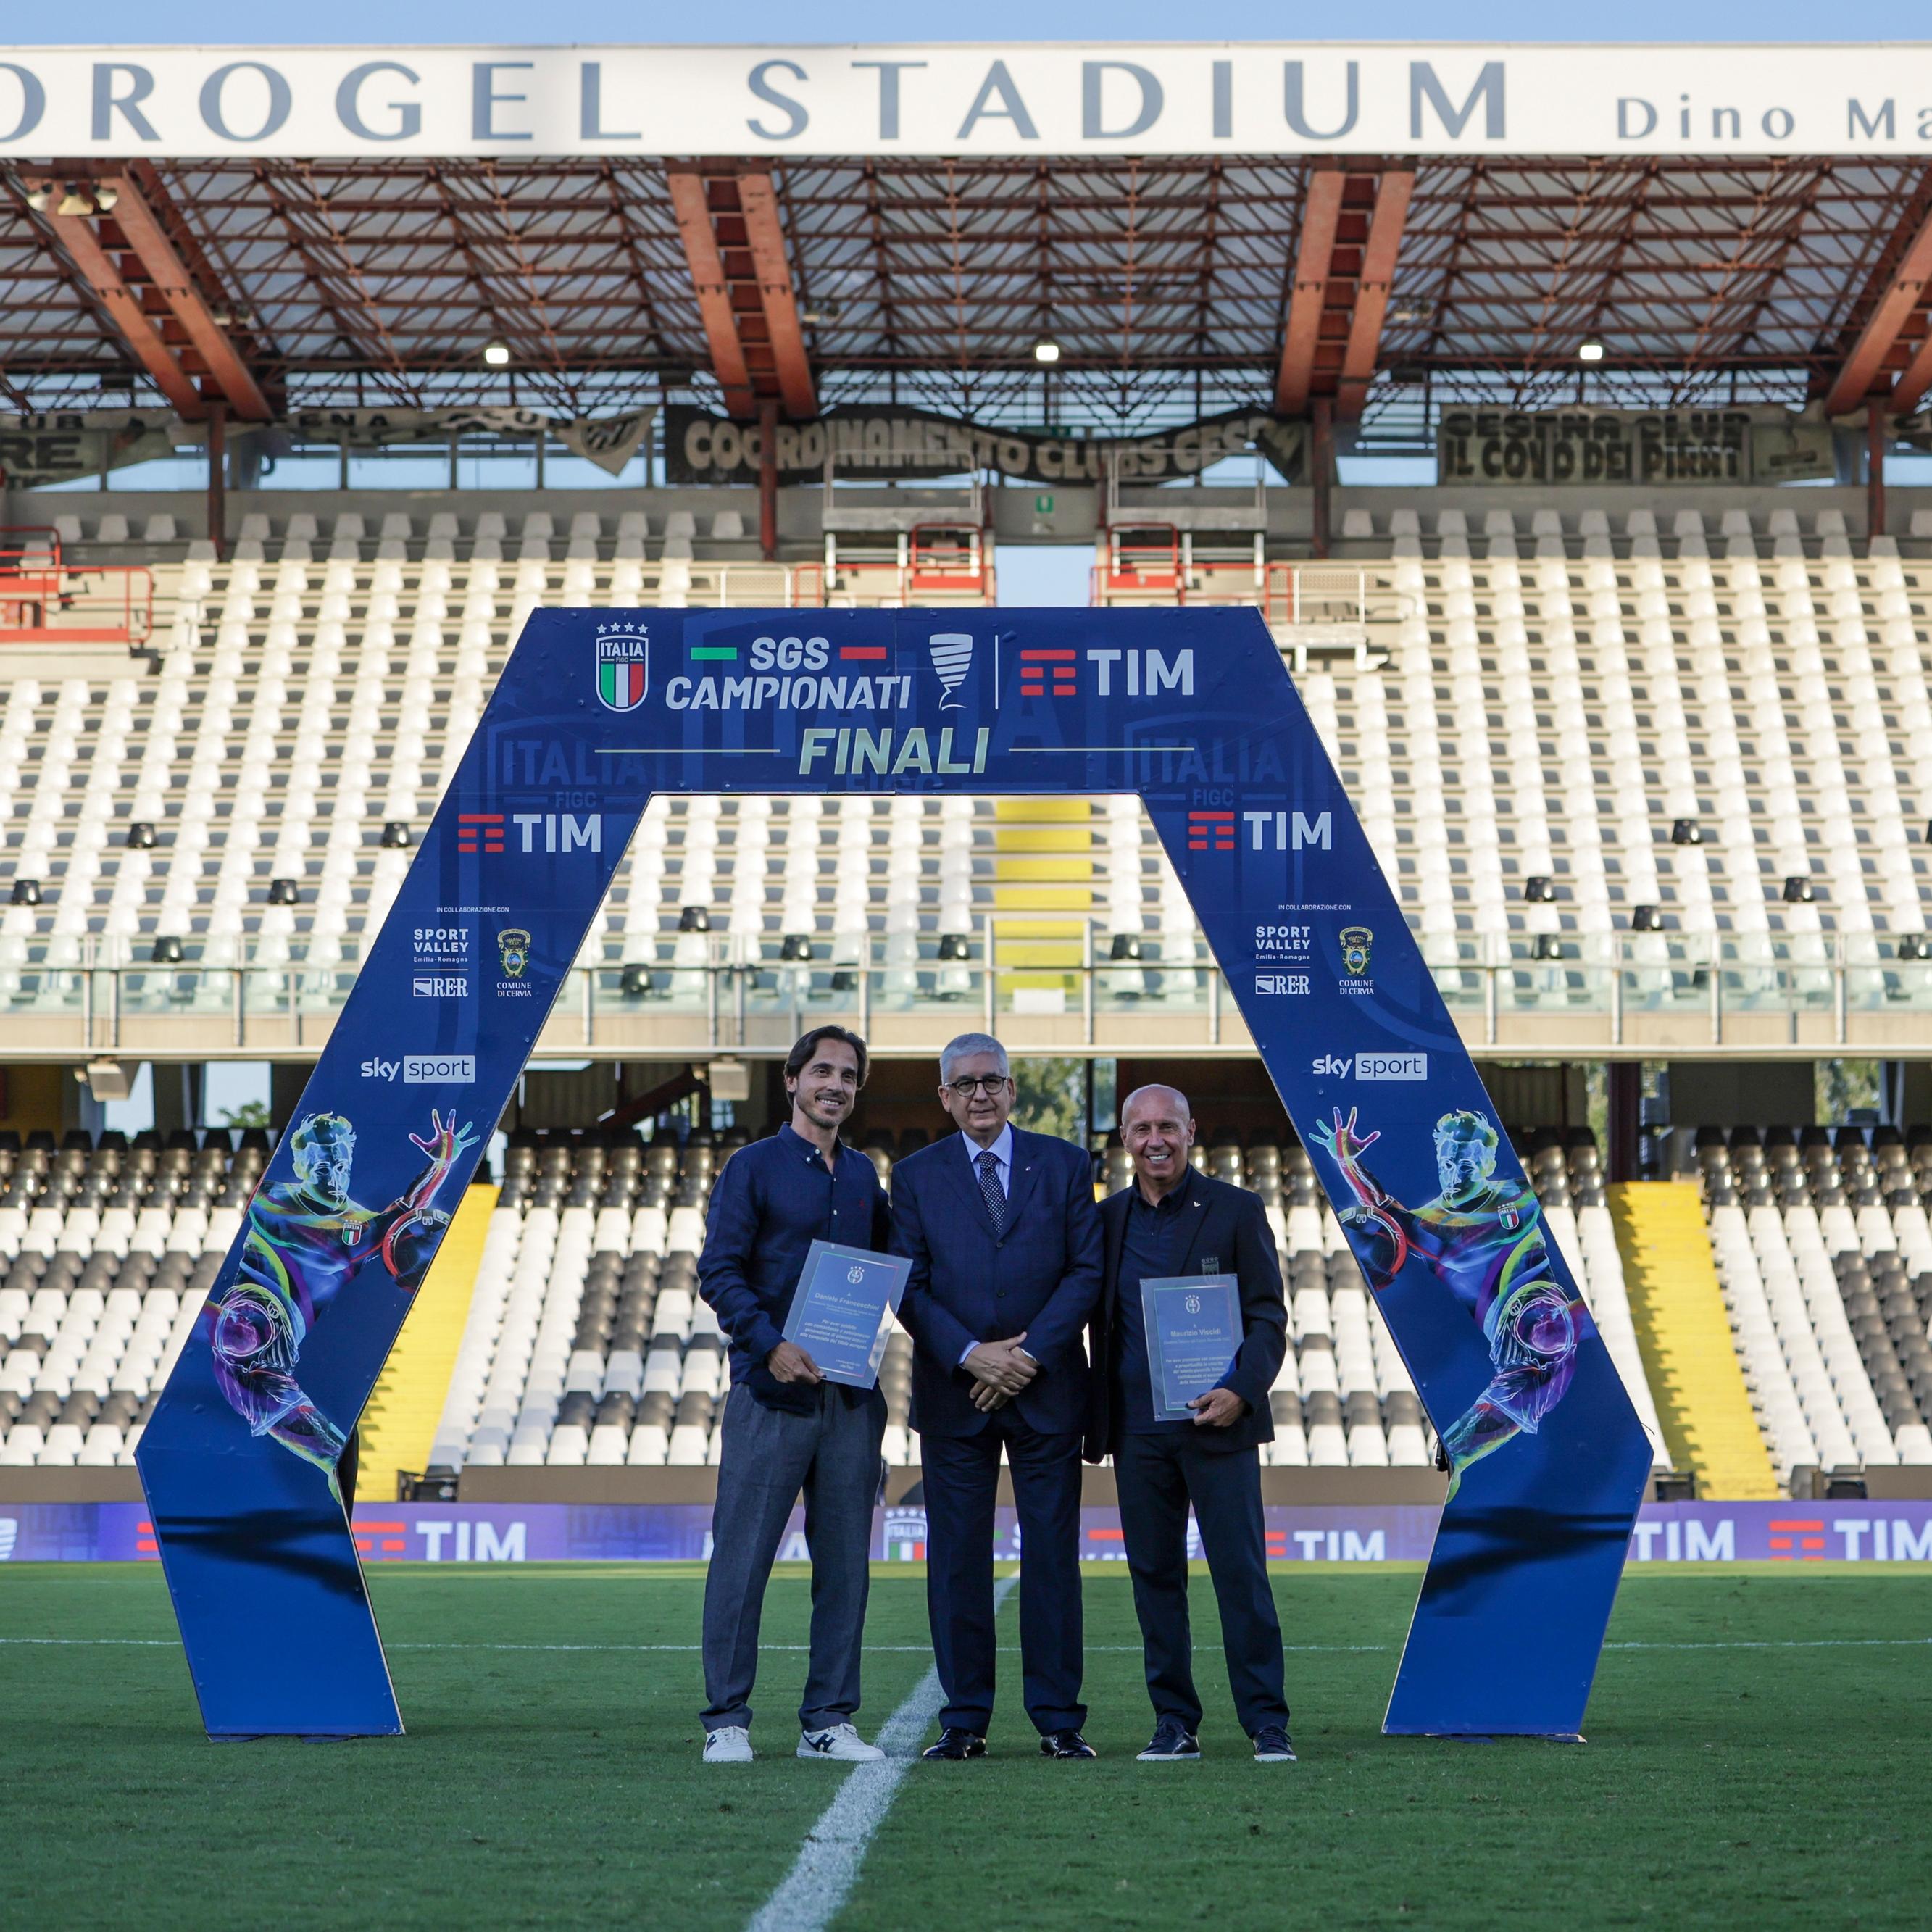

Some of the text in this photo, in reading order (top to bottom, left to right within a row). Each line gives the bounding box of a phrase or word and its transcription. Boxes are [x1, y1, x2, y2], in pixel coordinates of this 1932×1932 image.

[747, 59, 1506, 141] STADIUM
[1617, 94, 1796, 140] Dino
[601, 642, 644, 657] ITALIA
[749, 637, 830, 670] SGS
[1087, 649, 1194, 696] TIM
[665, 675, 912, 710] CAMPIONATI
[799, 727, 991, 775] FINALI
[513, 814, 601, 852] TIM
[1243, 812, 1332, 850] TIM
[414, 928, 469, 941] SPORT
[414, 942, 469, 952] VALLEY
[1255, 926, 1311, 938] SPORT
[1255, 940, 1311, 950] VALLEY
[360, 1057, 470, 1082] sky sport
[1312, 1054, 1422, 1079] sky sport
[416, 1522, 526, 1562] TIM
[1293, 1530, 1385, 1561] TIM
[1633, 1520, 1735, 1561] TIM
[1833, 1519, 1932, 1561] TIM
